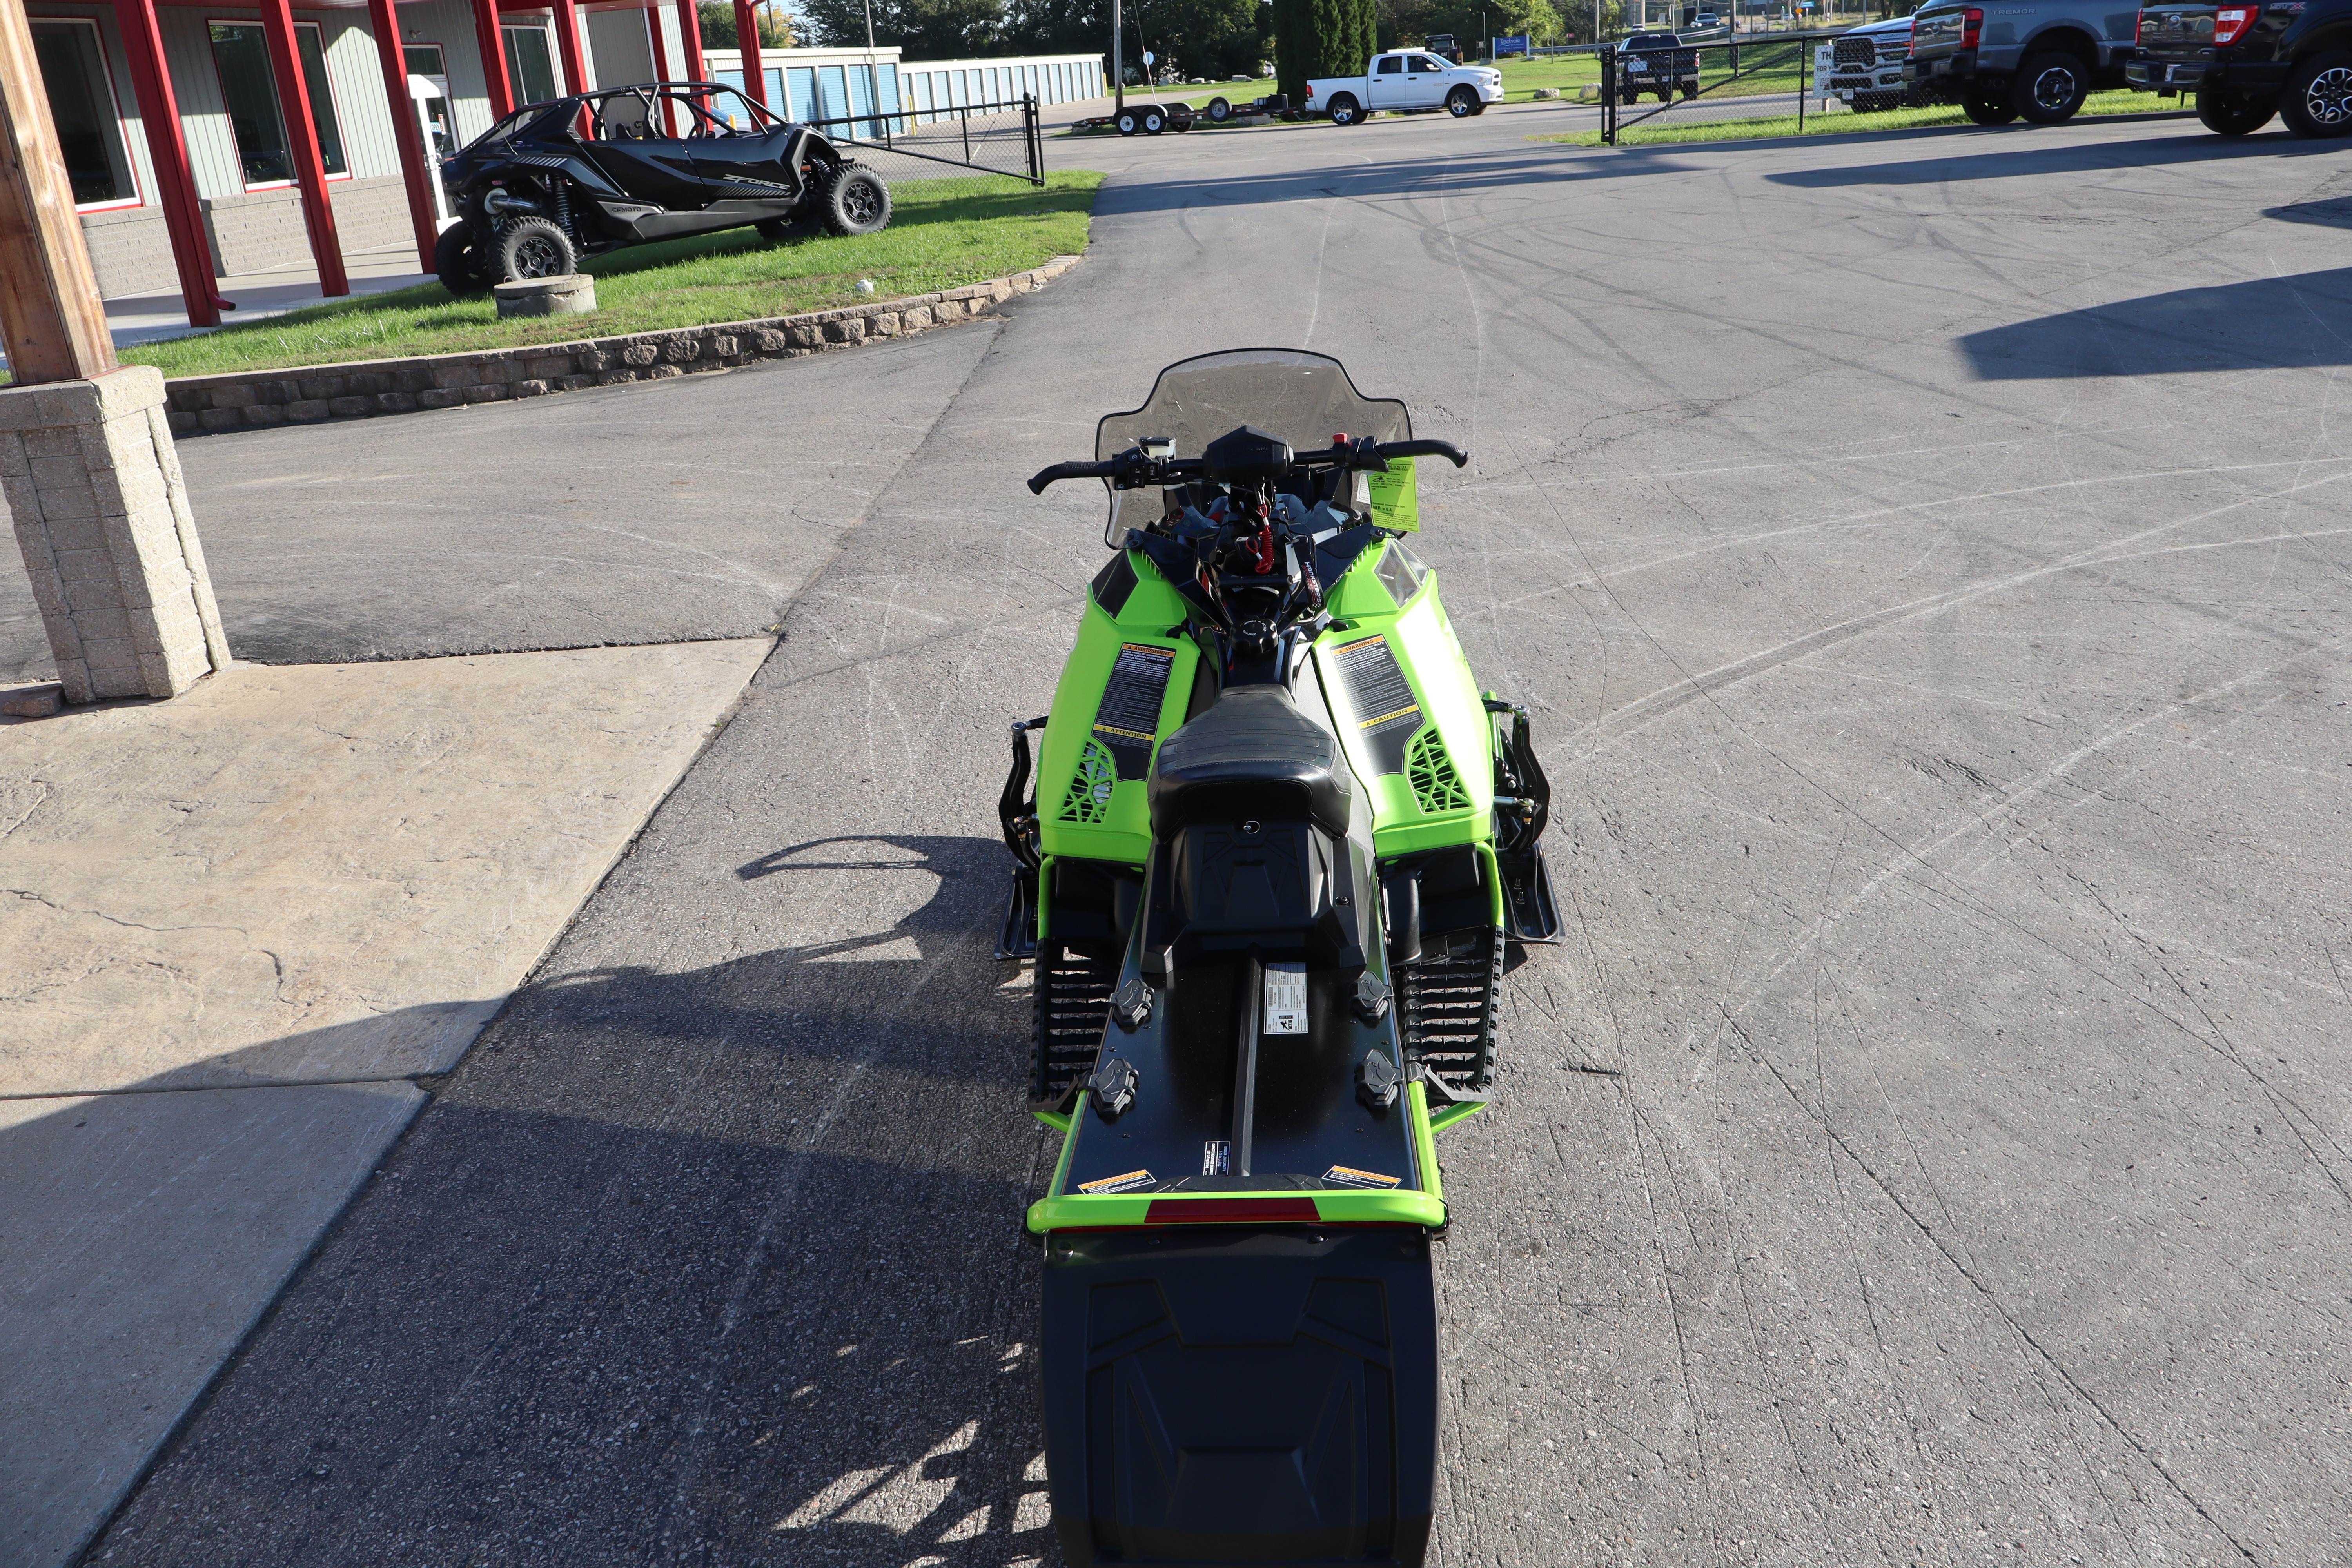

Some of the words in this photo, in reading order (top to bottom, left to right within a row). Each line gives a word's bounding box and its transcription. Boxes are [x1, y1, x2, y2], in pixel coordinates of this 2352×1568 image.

[2269, 2, 2307, 10] STX
[723, 174, 790, 190] ZFORCE
[1134, 646, 1171, 656] AVERTISSEMENT
[1345, 639, 1374, 651] WARNING
[1374, 709, 1408, 723] CAUTION
[1110, 729, 1146, 739] ATTENTION
[1095, 1173, 1139, 1185] AVERTISSEMENT
